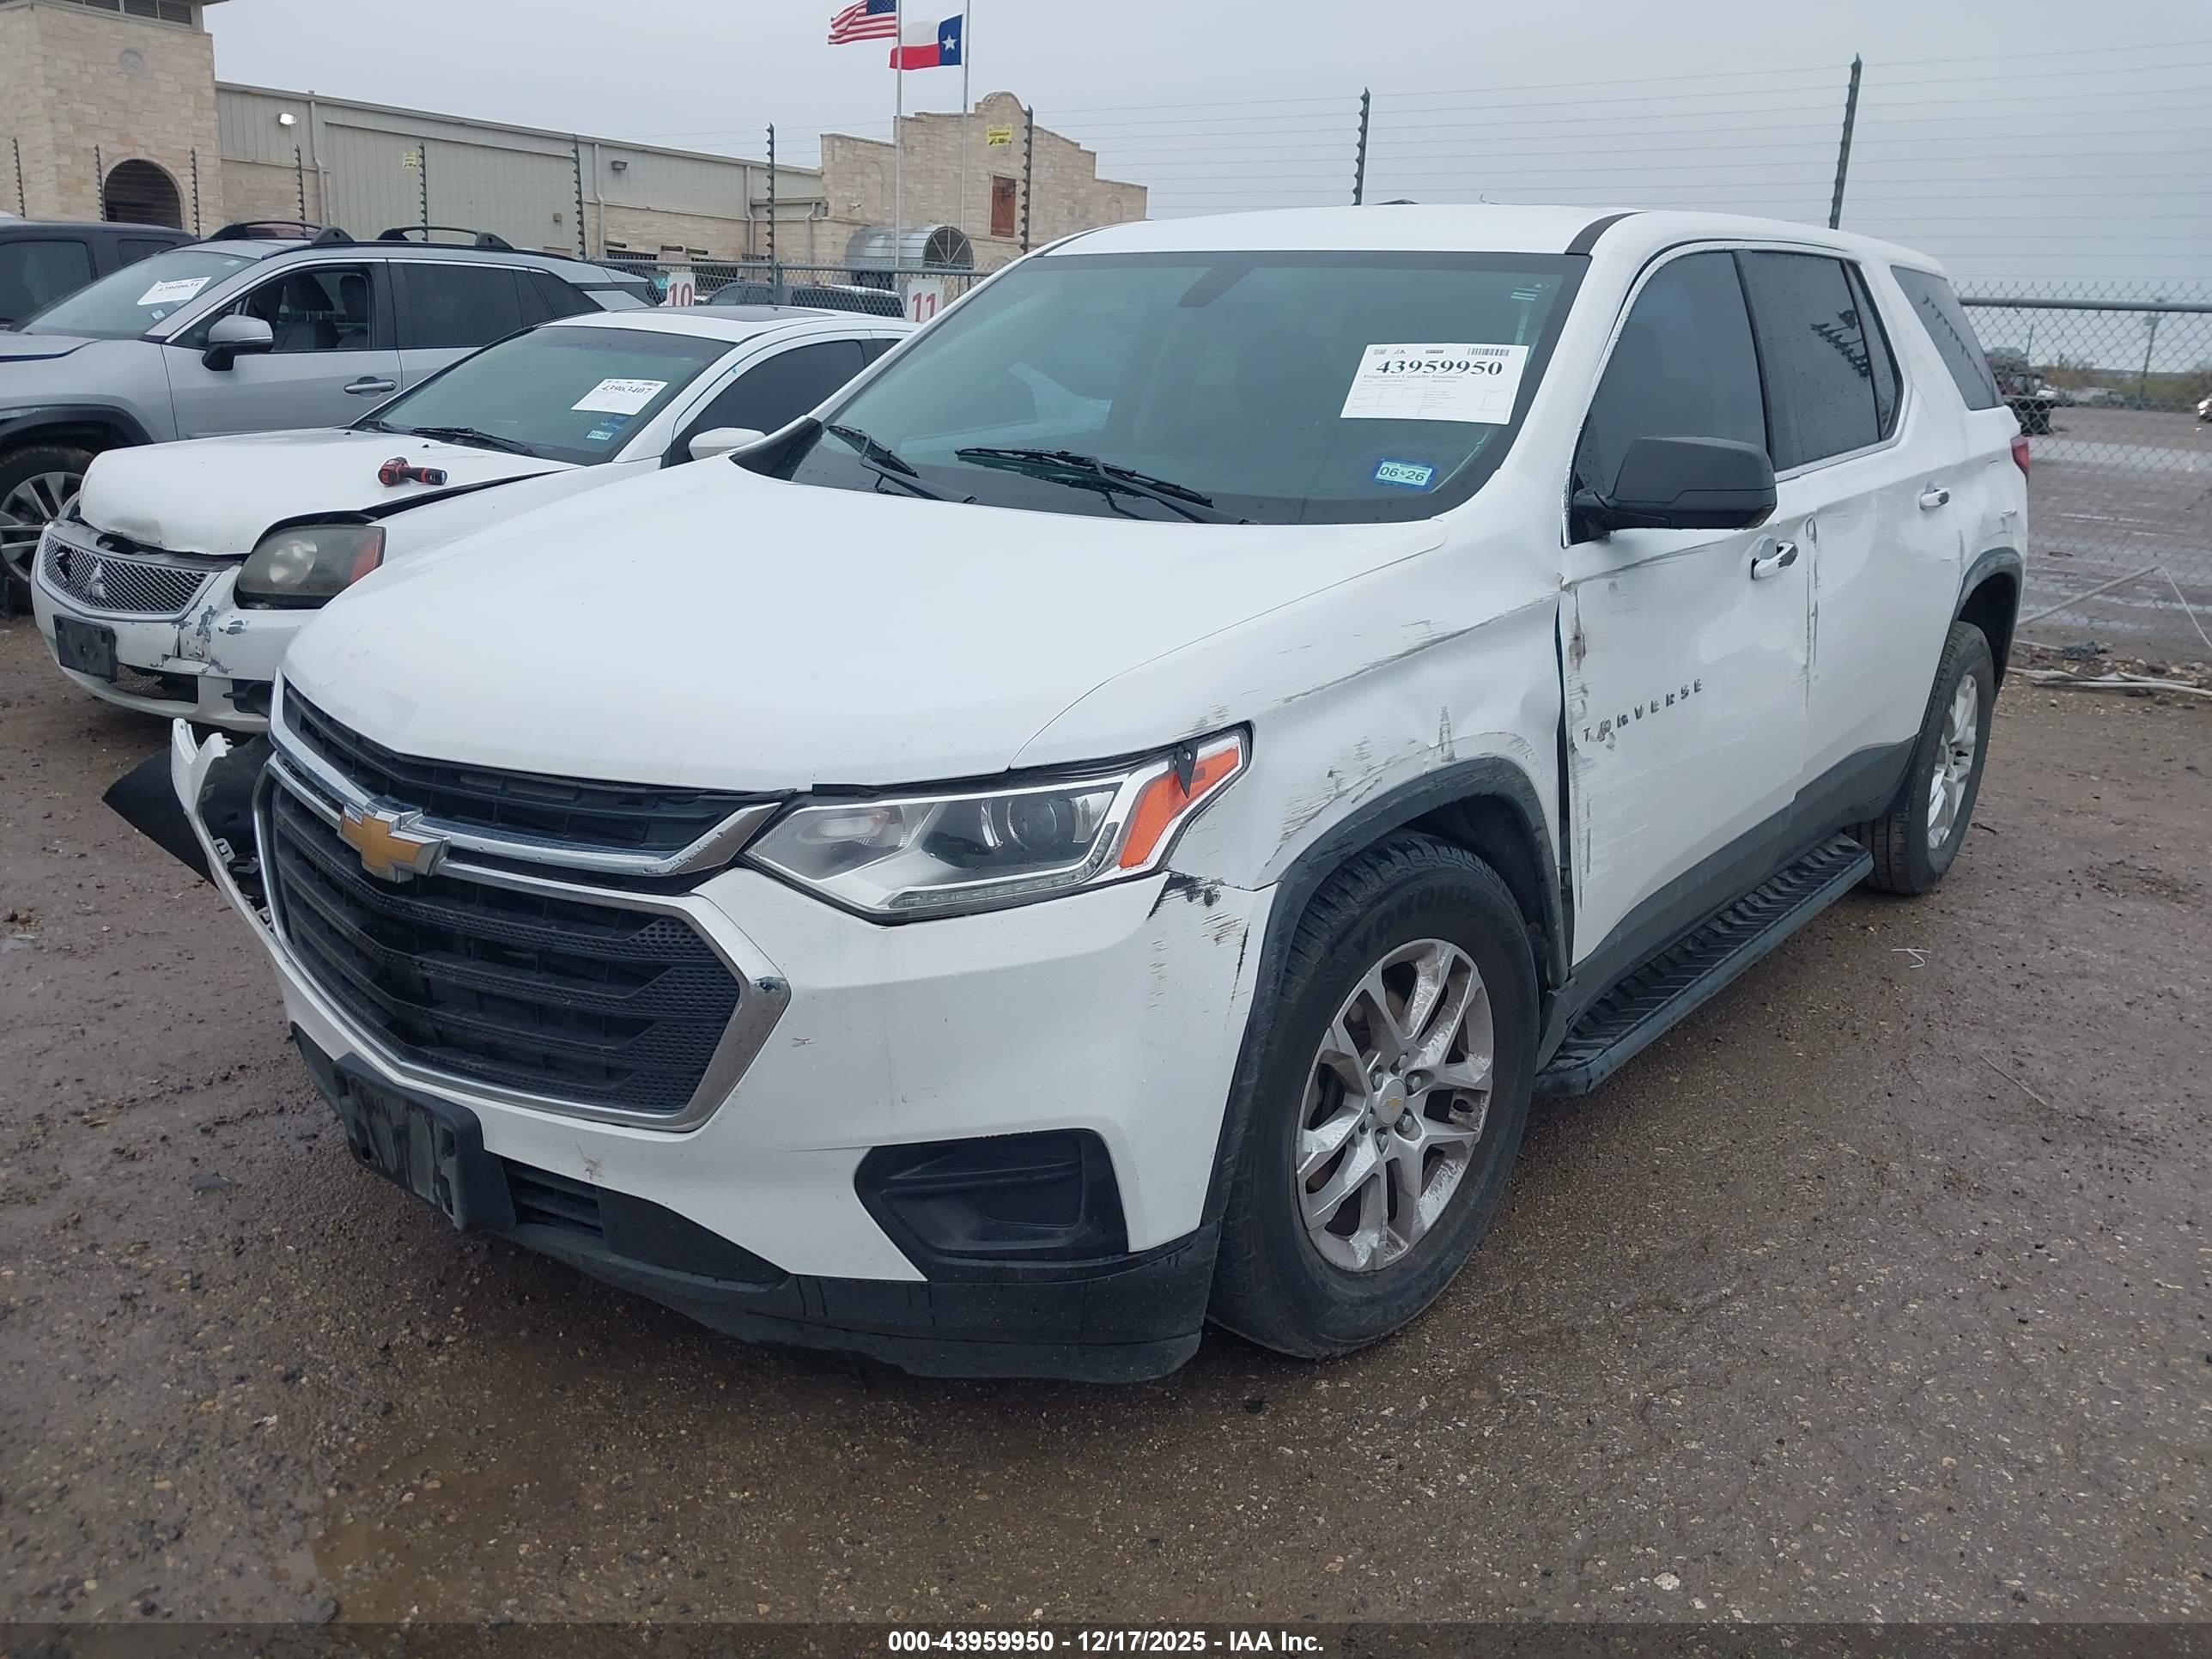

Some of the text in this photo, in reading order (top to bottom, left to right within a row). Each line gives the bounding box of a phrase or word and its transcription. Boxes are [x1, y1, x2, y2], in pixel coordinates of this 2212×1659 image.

[669, 283, 693, 307] 10
[912, 293, 936, 323] 11
[1376, 360, 1503, 376] 43959950
[1380, 466, 1426, 482] 06 26
